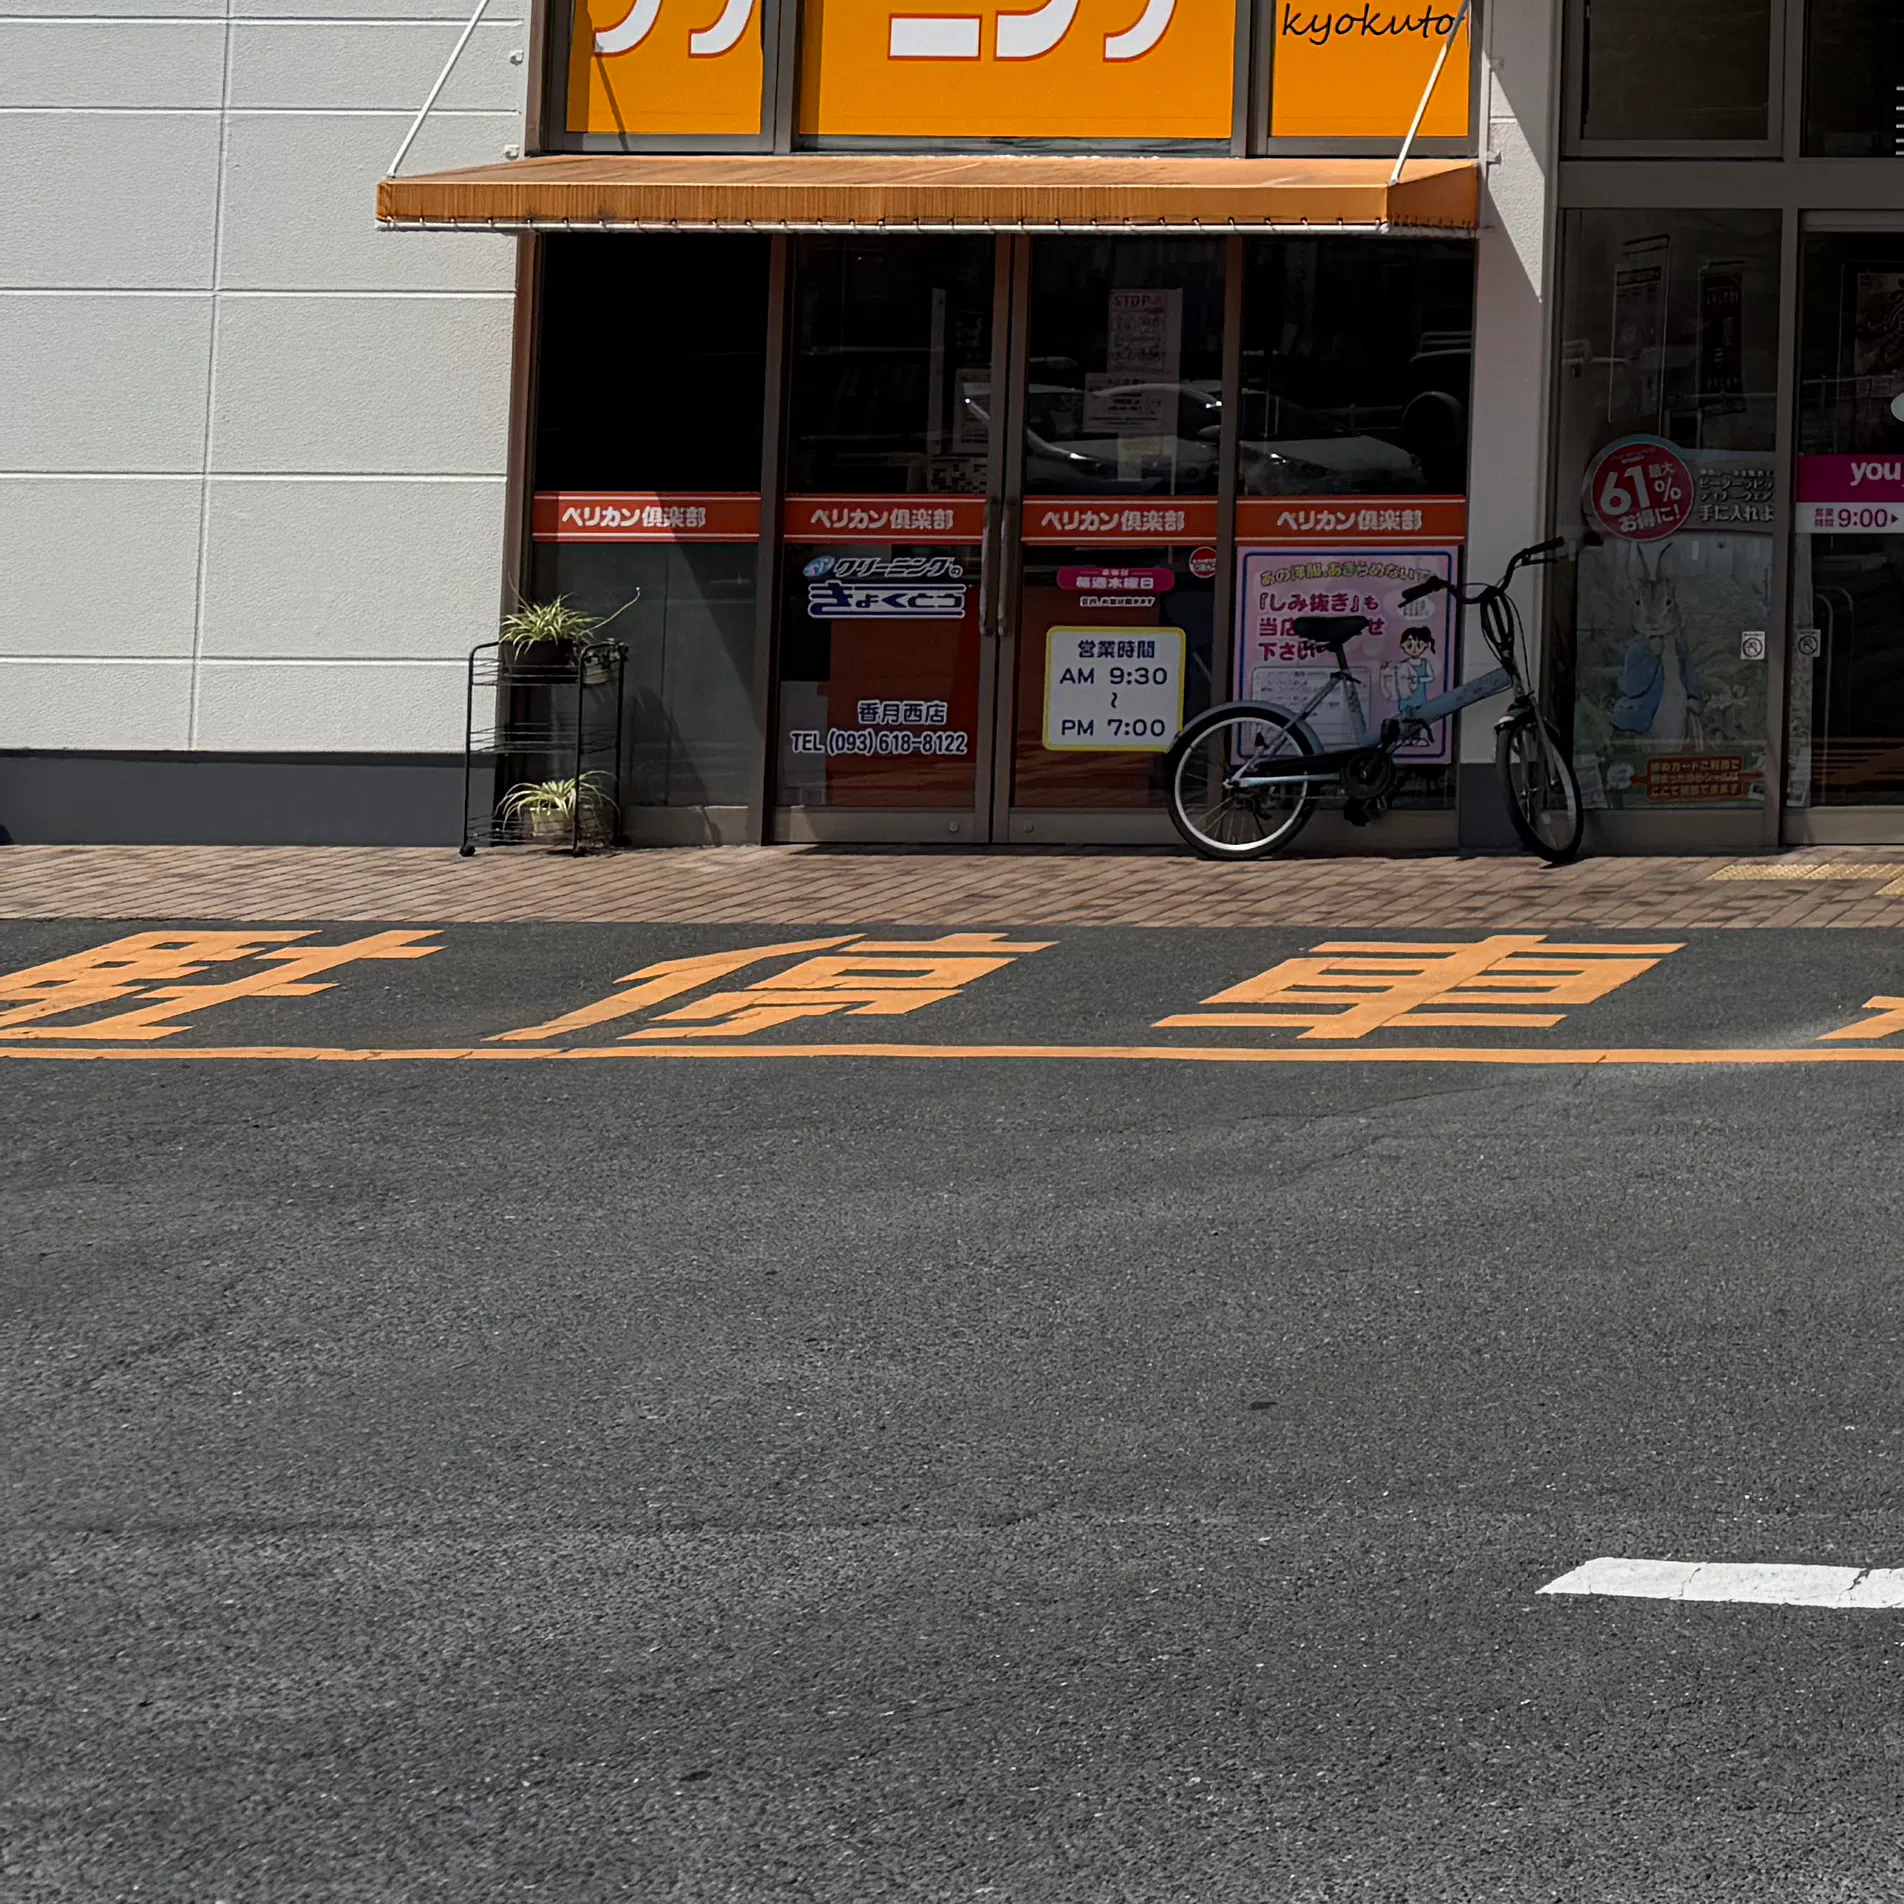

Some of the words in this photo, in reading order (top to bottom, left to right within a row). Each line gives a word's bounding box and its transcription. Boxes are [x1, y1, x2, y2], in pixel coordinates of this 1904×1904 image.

[1282, 3, 1465, 46] kyokuto
[1077, 639, 1156, 659] 営業時間
[1059, 667, 1095, 685] AM
[1109, 667, 1168, 685] 9:30
[857, 699, 948, 726] 香月西店
[1061, 719, 1095, 736] PM
[1107, 718, 1166, 737] 7:00
[790, 730, 825, 754] TEL
